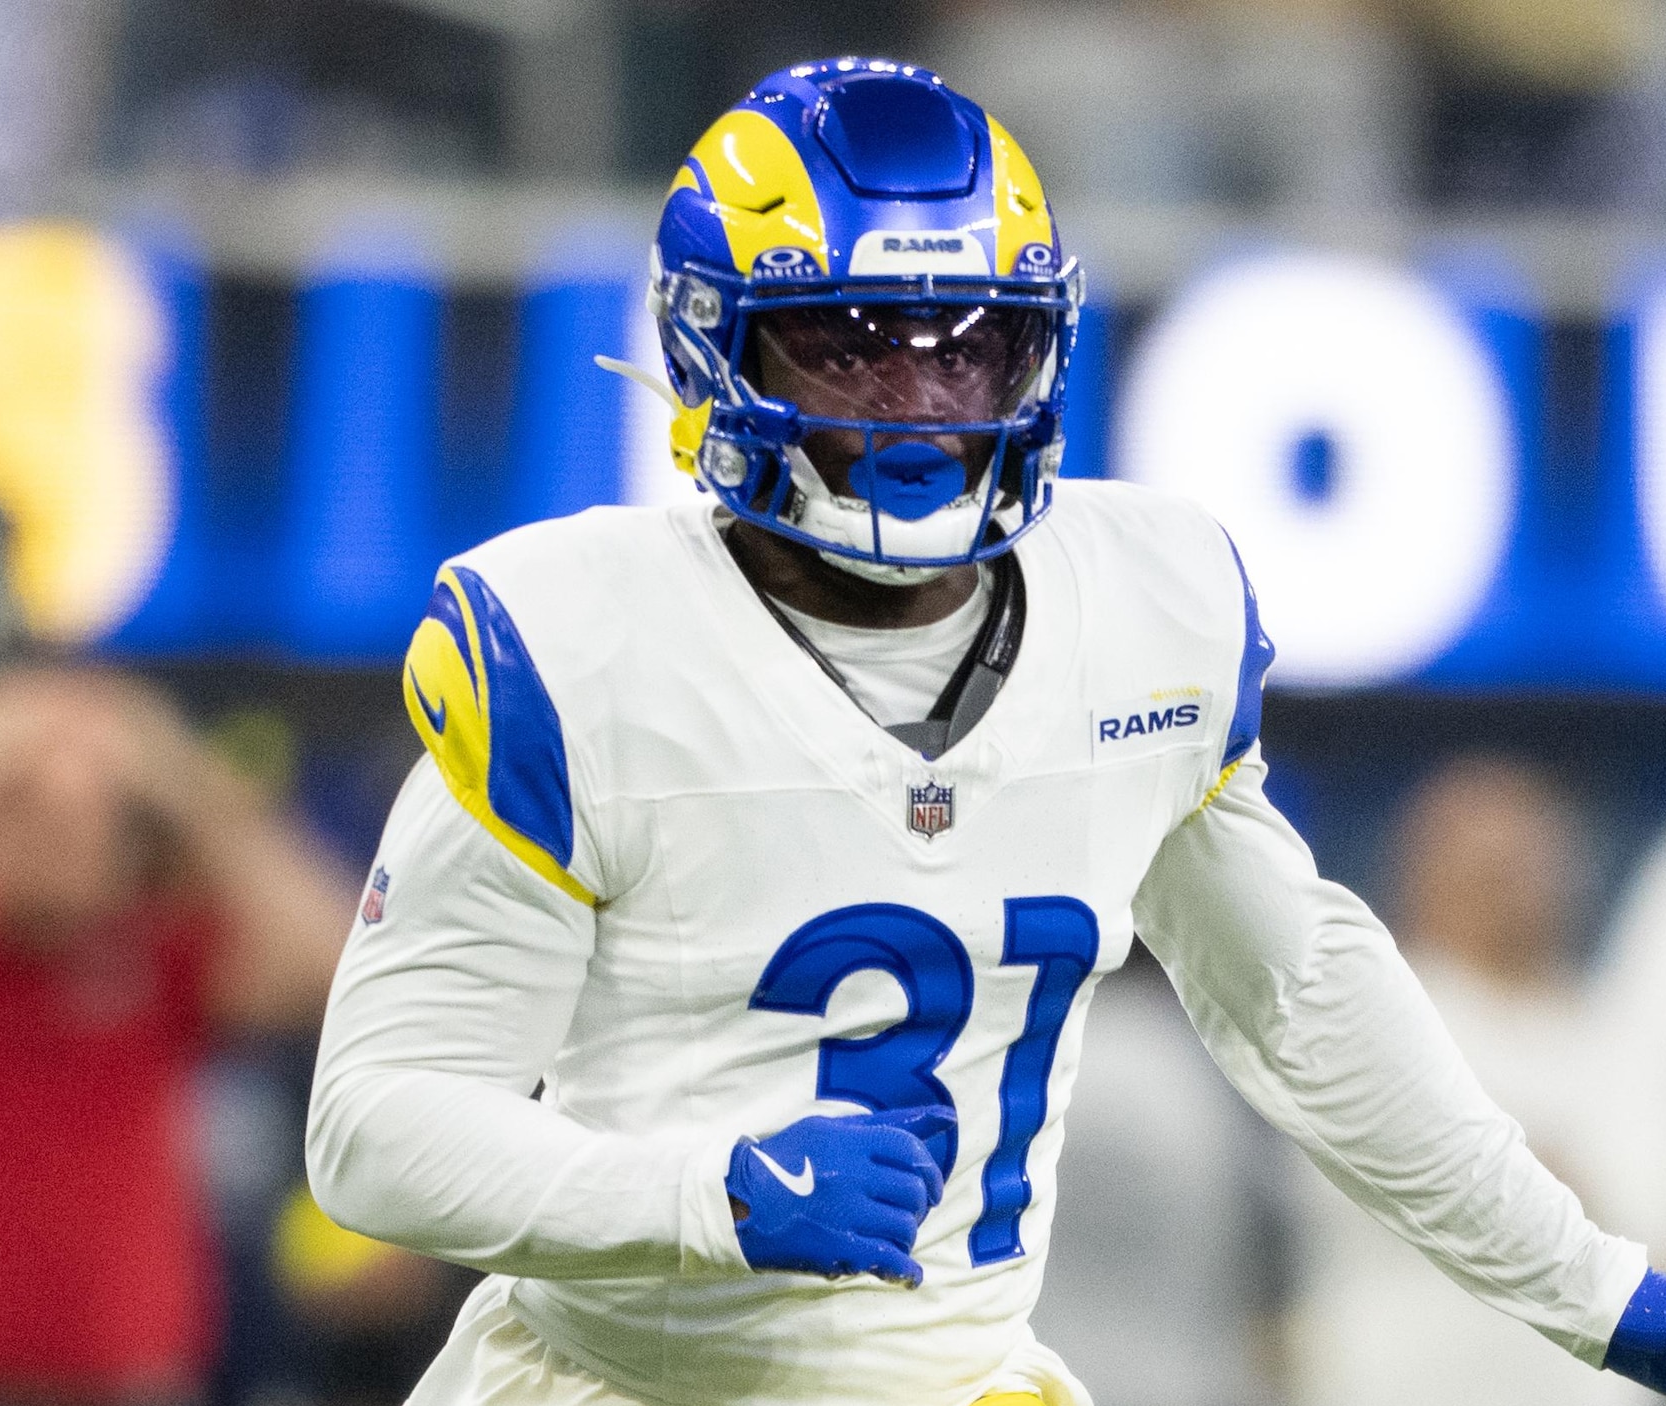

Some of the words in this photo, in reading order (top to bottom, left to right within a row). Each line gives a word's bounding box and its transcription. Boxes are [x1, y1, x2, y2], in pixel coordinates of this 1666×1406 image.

[883, 238, 964, 252] RAMS
[1099, 703, 1200, 743] RAMS
[916, 806, 949, 831] NFL
[748, 895, 1100, 1268] 31
